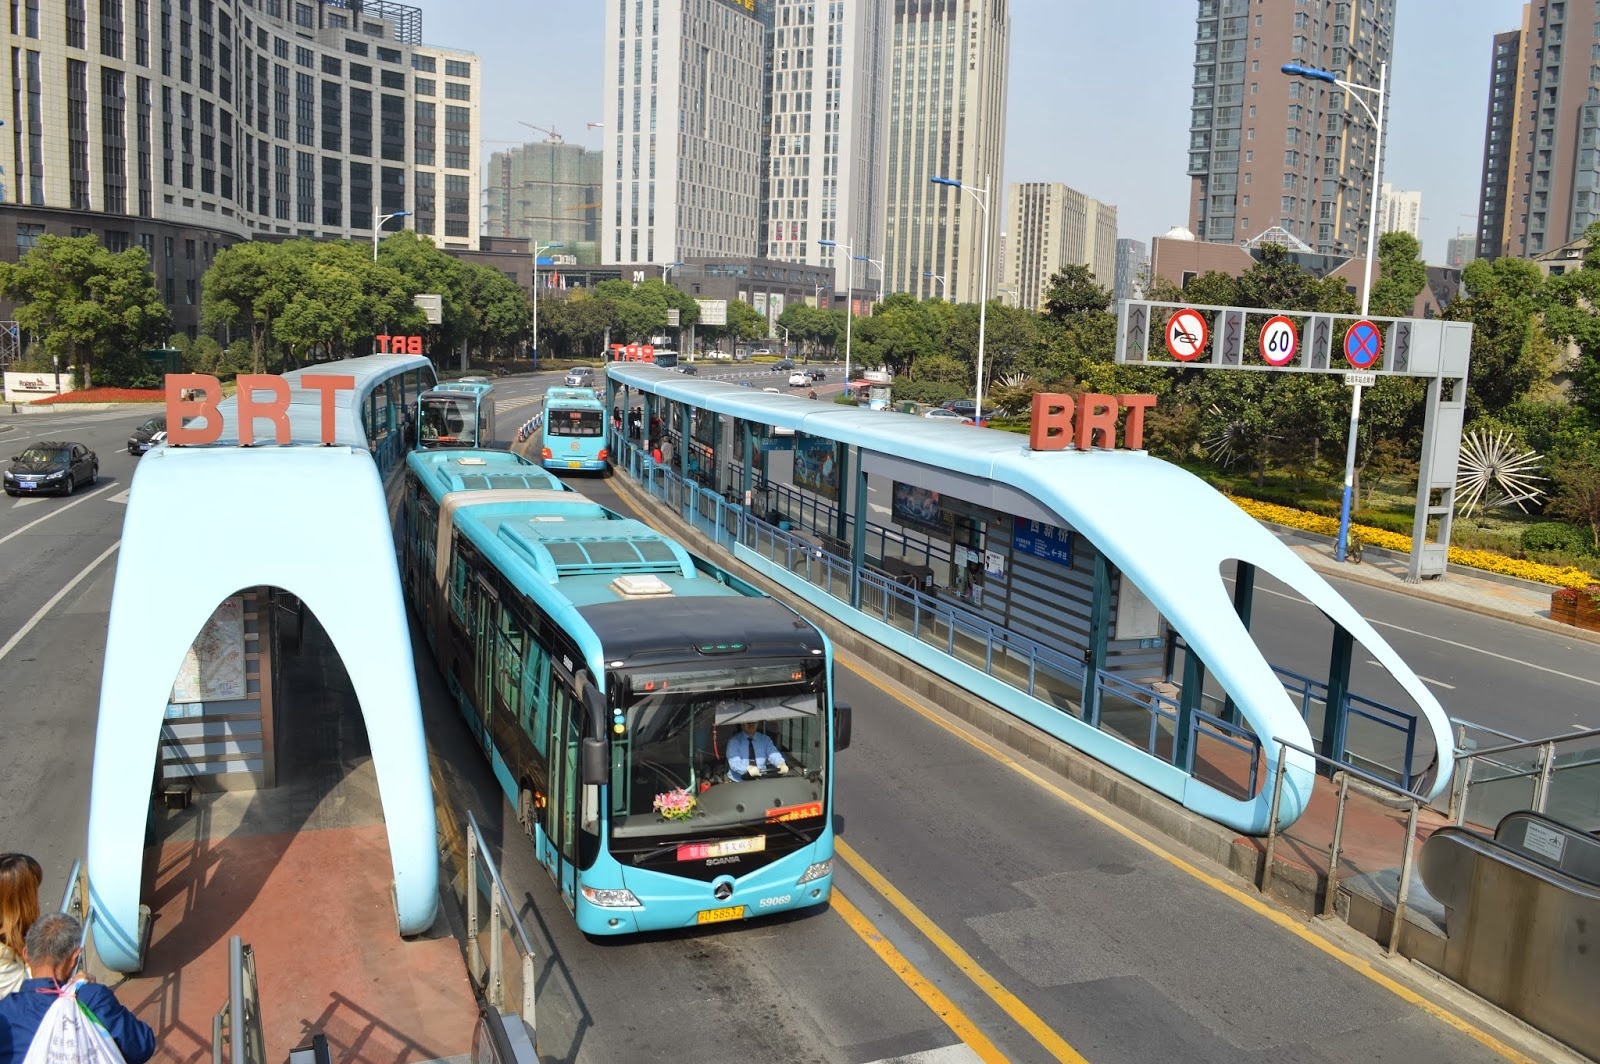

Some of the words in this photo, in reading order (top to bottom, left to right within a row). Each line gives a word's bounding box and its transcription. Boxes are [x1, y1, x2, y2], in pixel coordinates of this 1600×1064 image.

[1268, 329, 1289, 353] 60
[164, 373, 355, 446] BRT
[1030, 392, 1157, 451] BRT
[705, 855, 741, 867] SCANIA
[759, 895, 792, 908] 59069
